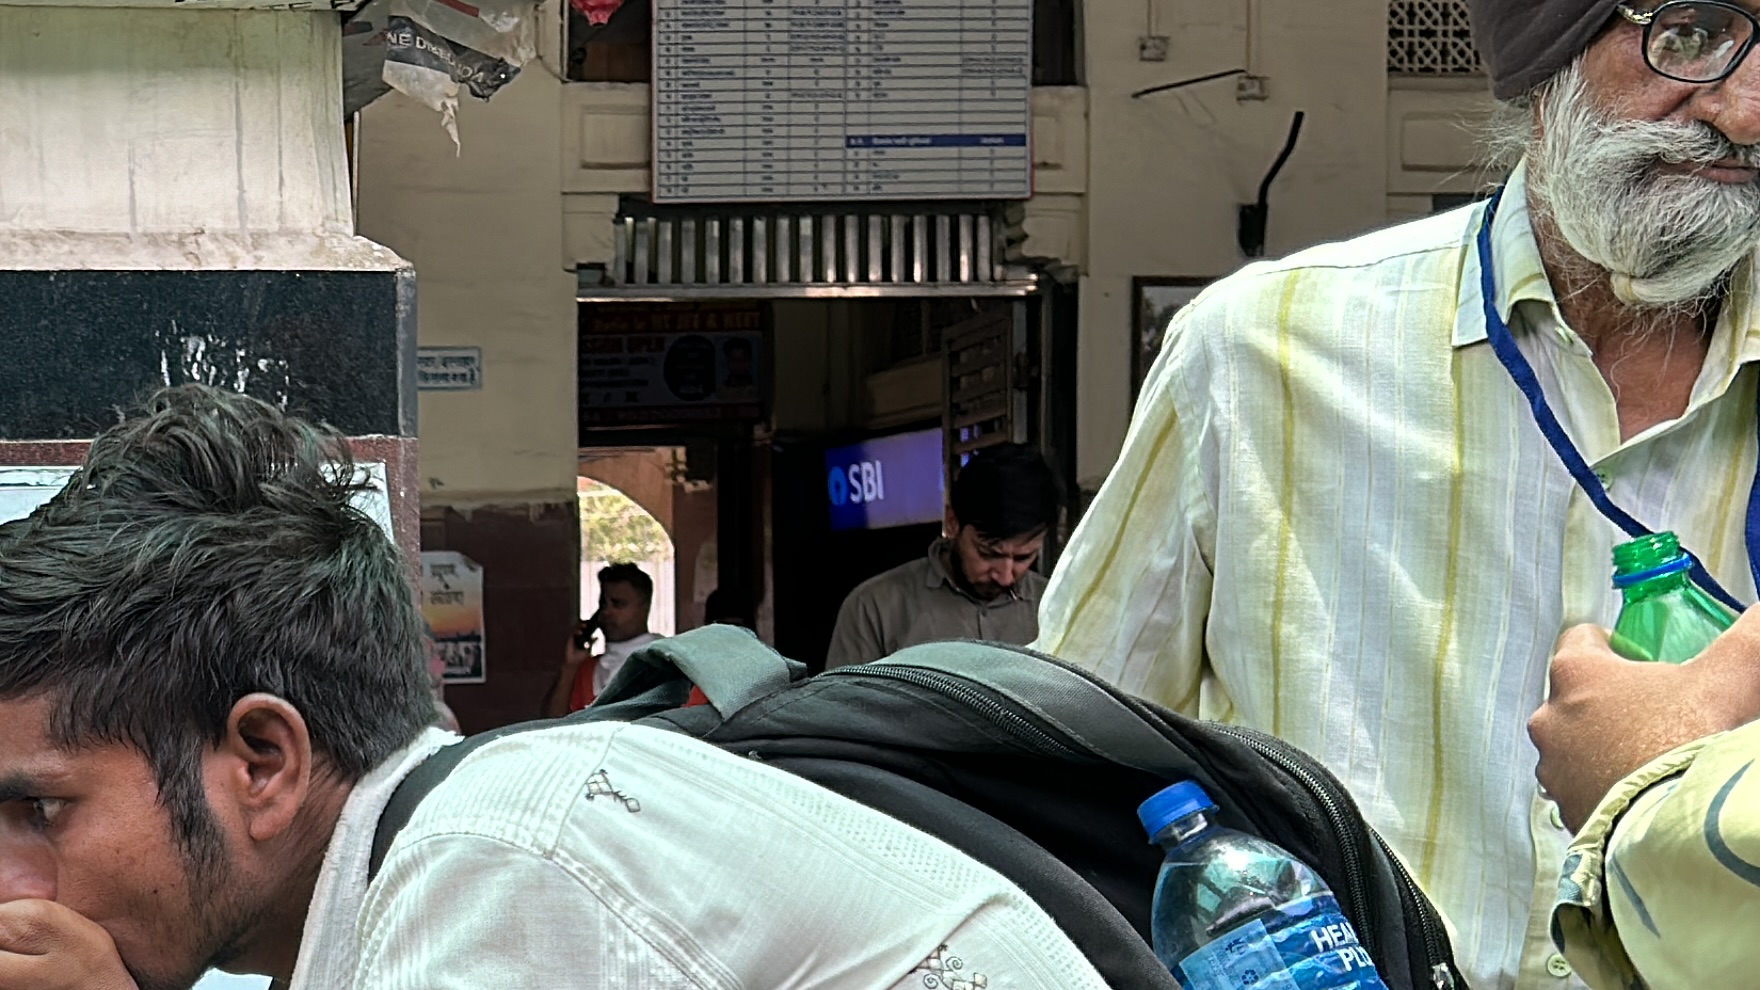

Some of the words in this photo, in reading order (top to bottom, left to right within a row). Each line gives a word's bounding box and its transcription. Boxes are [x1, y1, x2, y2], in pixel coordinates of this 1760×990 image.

[848, 459, 884, 505] SBI
[1310, 921, 1360, 953] HEA
[1336, 945, 1374, 972] PLU
